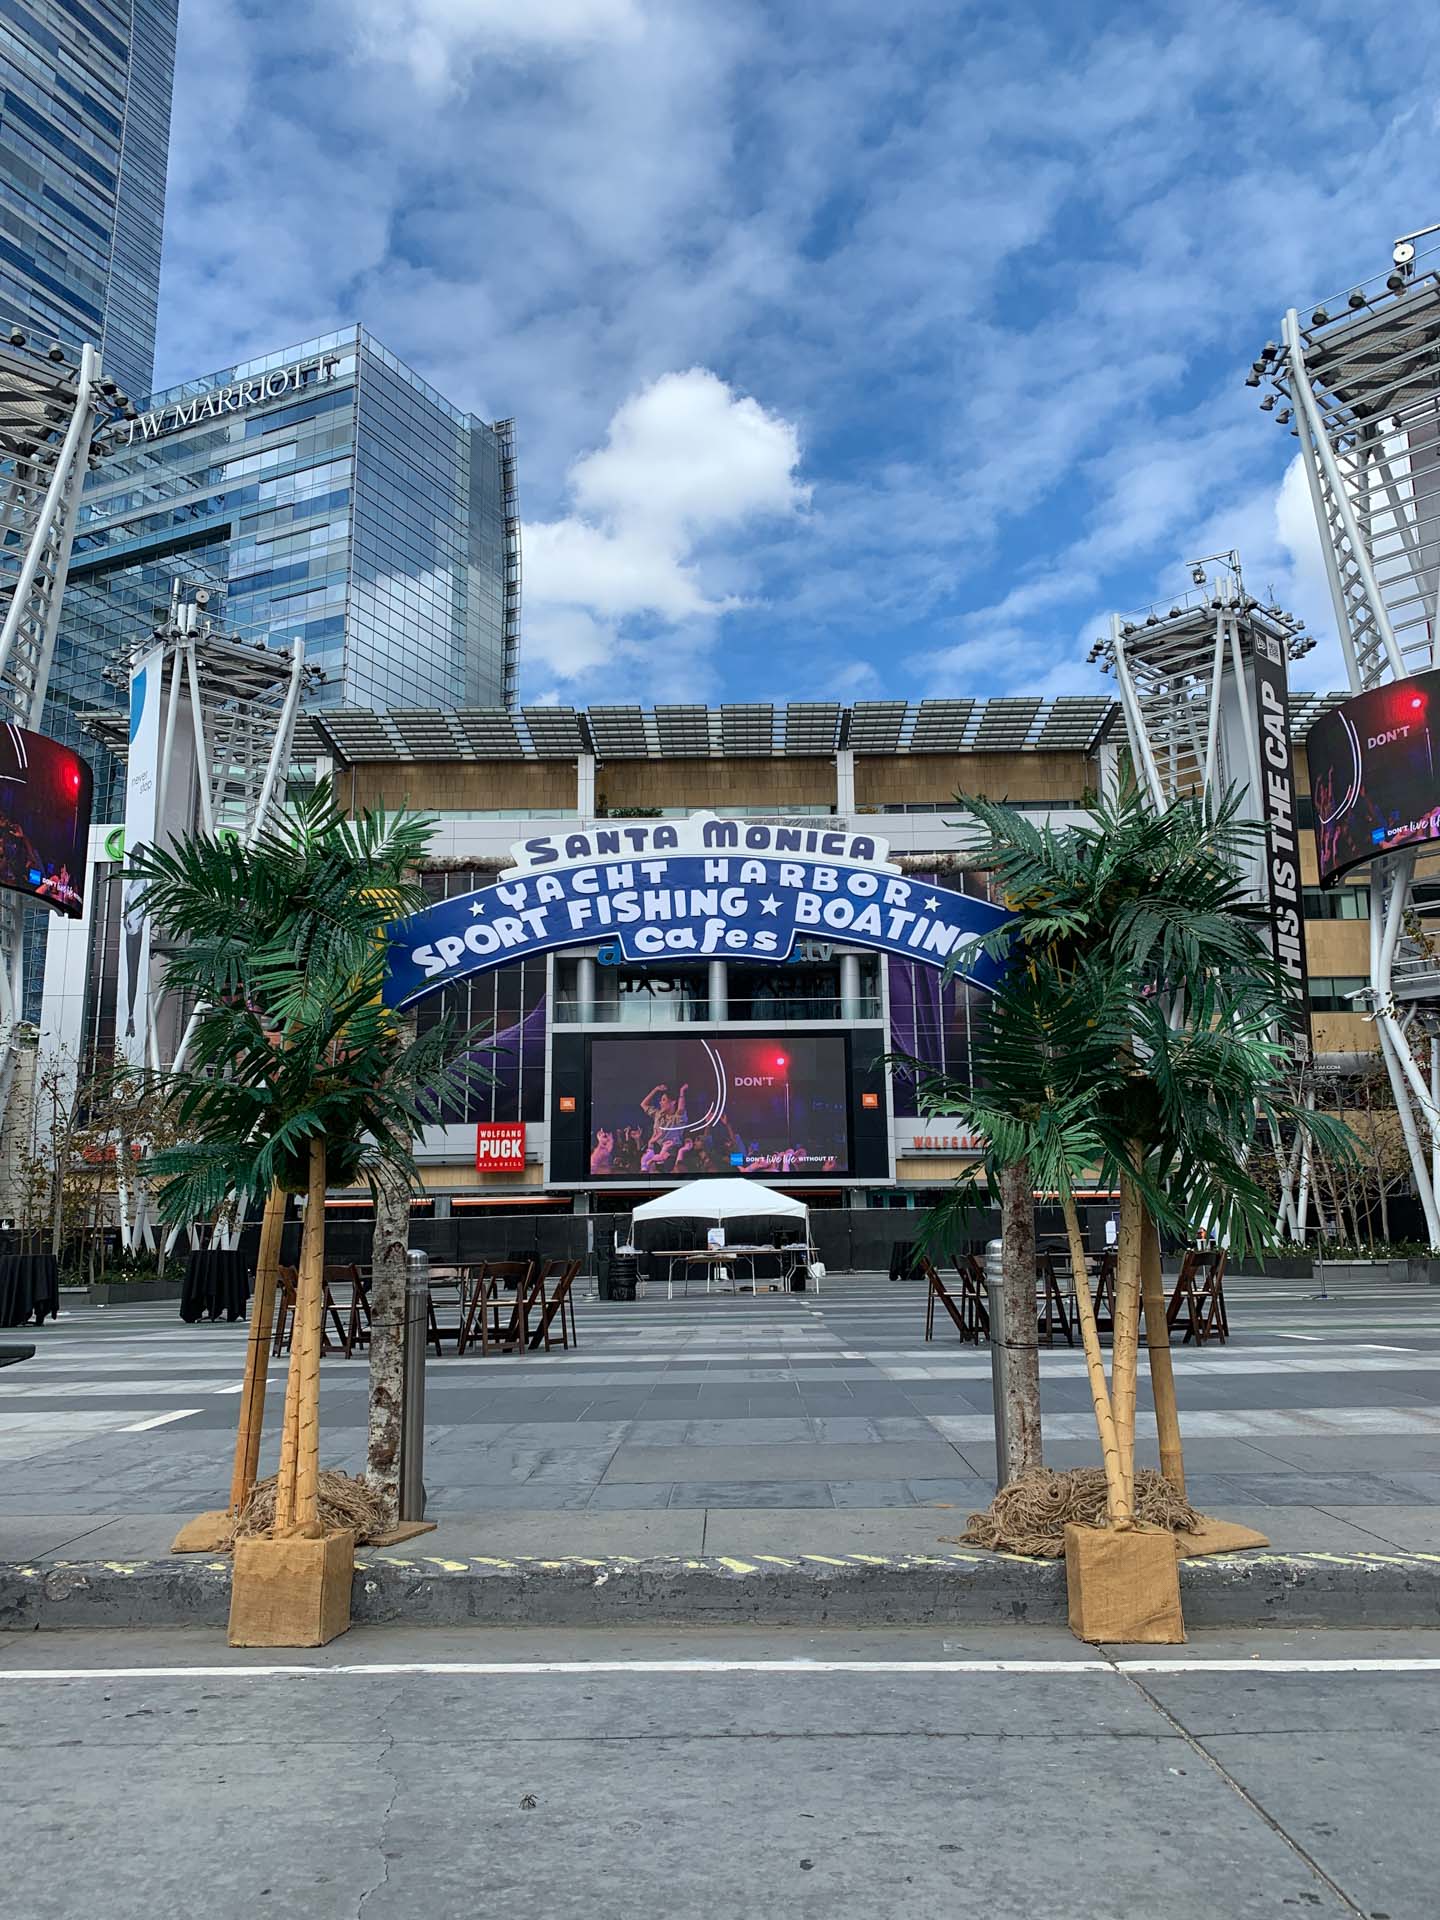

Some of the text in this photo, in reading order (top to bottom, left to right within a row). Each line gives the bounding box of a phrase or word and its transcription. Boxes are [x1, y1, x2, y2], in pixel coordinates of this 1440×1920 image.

[126, 353, 335, 447] JW MARRIOTT
[1261, 680, 1288, 769] CAP
[1367, 725, 1410, 750] DON'T
[1267, 770, 1294, 853] THE
[1387, 825, 1409, 836] DON'T
[525, 820, 875, 866] SANTA MONICA
[495, 859, 912, 911] YACHT HARBOR
[1273, 858, 1297, 902] IS
[411, 906, 548, 978] SPORT
[566, 887, 749, 930] FISHING
[734, 1076, 775, 1087] DON'T
[480, 1130, 522, 1138] WOLFGANG
[480, 1139, 522, 1159] PUCK
